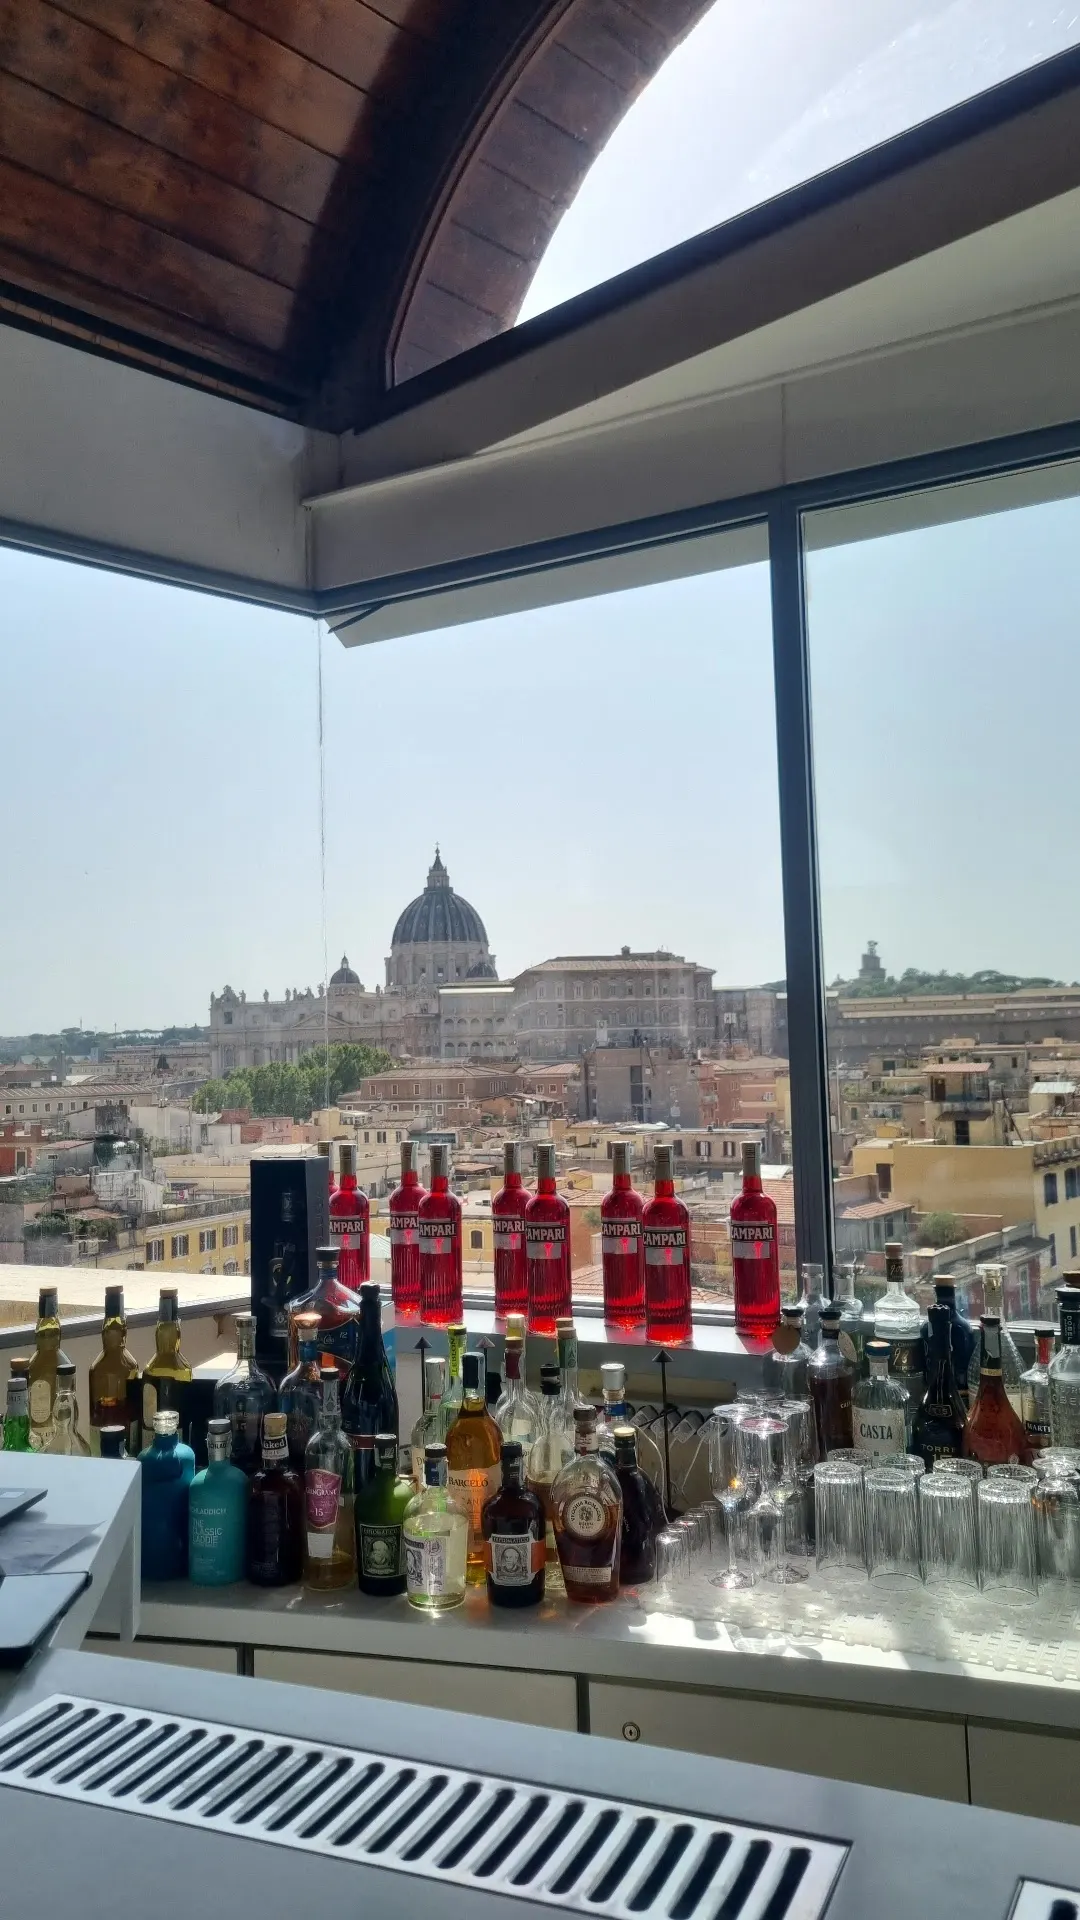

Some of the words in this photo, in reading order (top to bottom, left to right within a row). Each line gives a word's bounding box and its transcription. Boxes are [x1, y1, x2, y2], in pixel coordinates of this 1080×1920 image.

[329, 1220, 364, 1233] AMPARI
[391, 1216, 419, 1228] AMPA
[494, 1220, 525, 1233] MPARI
[419, 1223, 455, 1236] AMPARI
[526, 1227, 565, 1241] AMPARI
[602, 1223, 641, 1236] AMPARI
[643, 1232, 686, 1245] CAMPARI
[450, 1338, 458, 1373] LEBLON
[860, 1423, 893, 1440] CASTA
[265, 1438, 285, 1449] aked
[448, 1477, 489, 1489] BARCELÓ
[314, 1507, 324, 1517] 15
